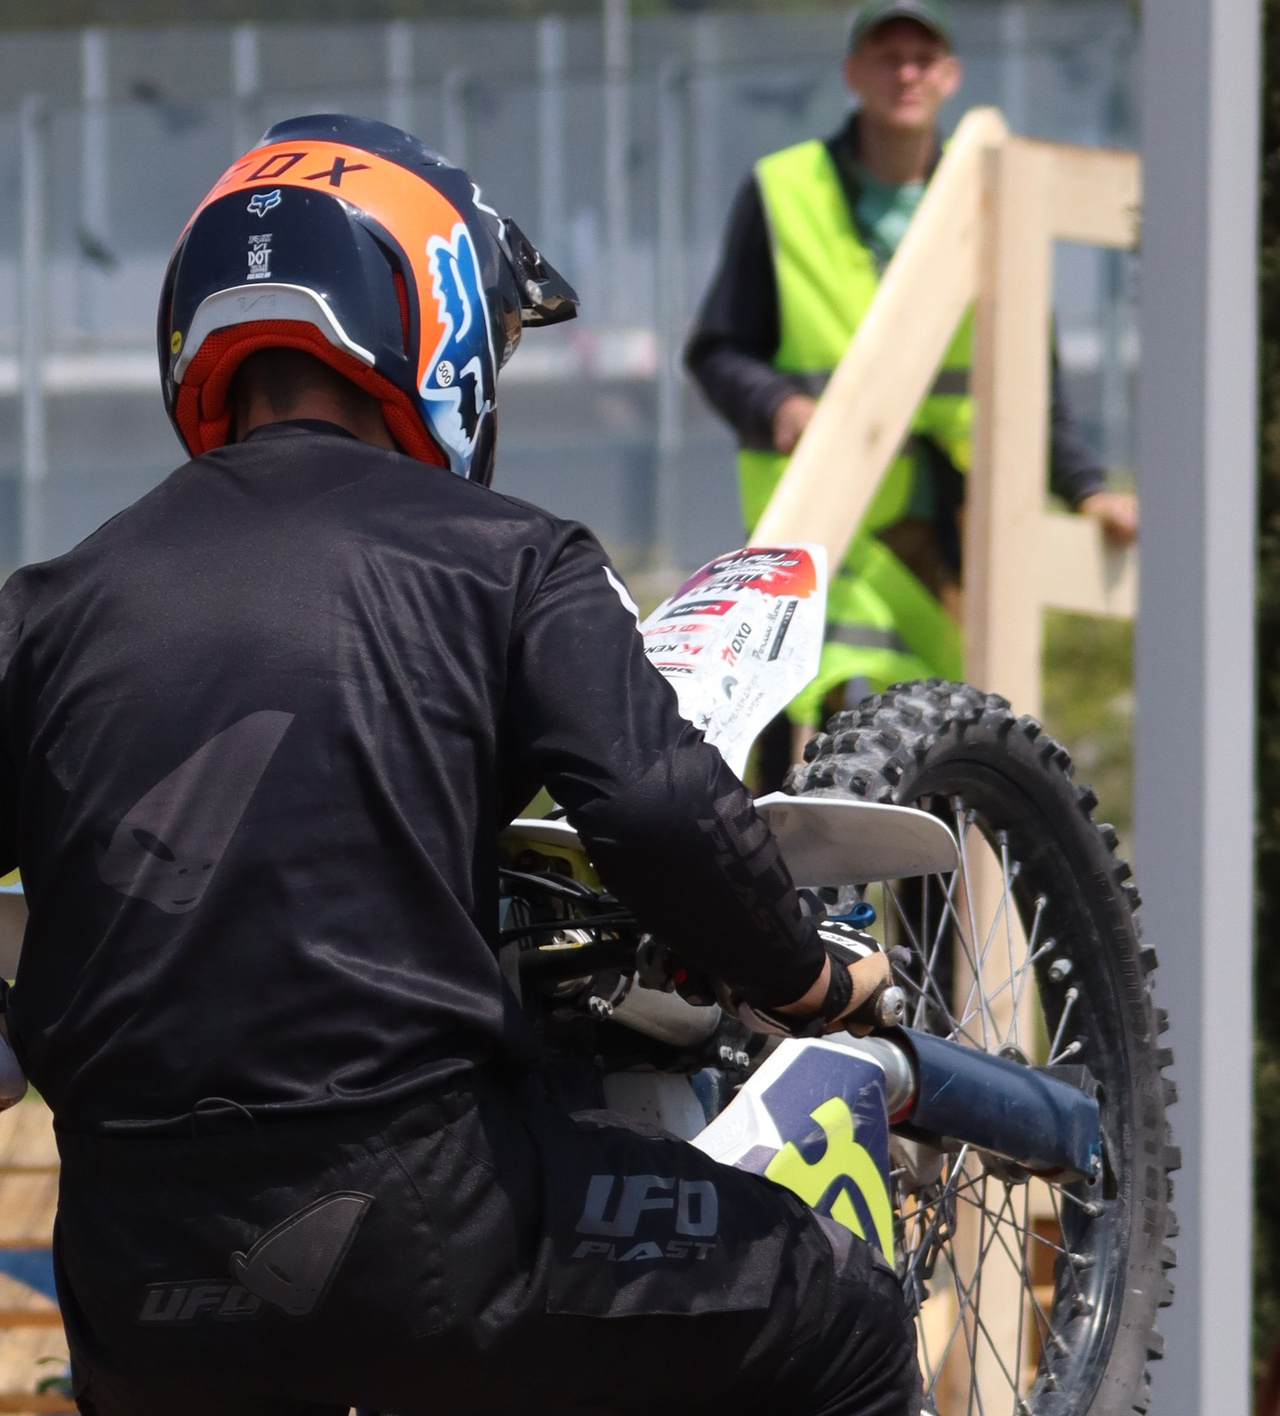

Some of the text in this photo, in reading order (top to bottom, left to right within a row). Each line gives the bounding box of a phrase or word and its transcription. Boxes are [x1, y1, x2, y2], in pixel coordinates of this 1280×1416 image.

[247, 249, 272, 267] DOT
[436, 362, 452, 385] 300
[643, 644, 680, 654] KEN
[575, 1174, 719, 1238] UFO
[571, 1241, 716, 1263] PLAST
